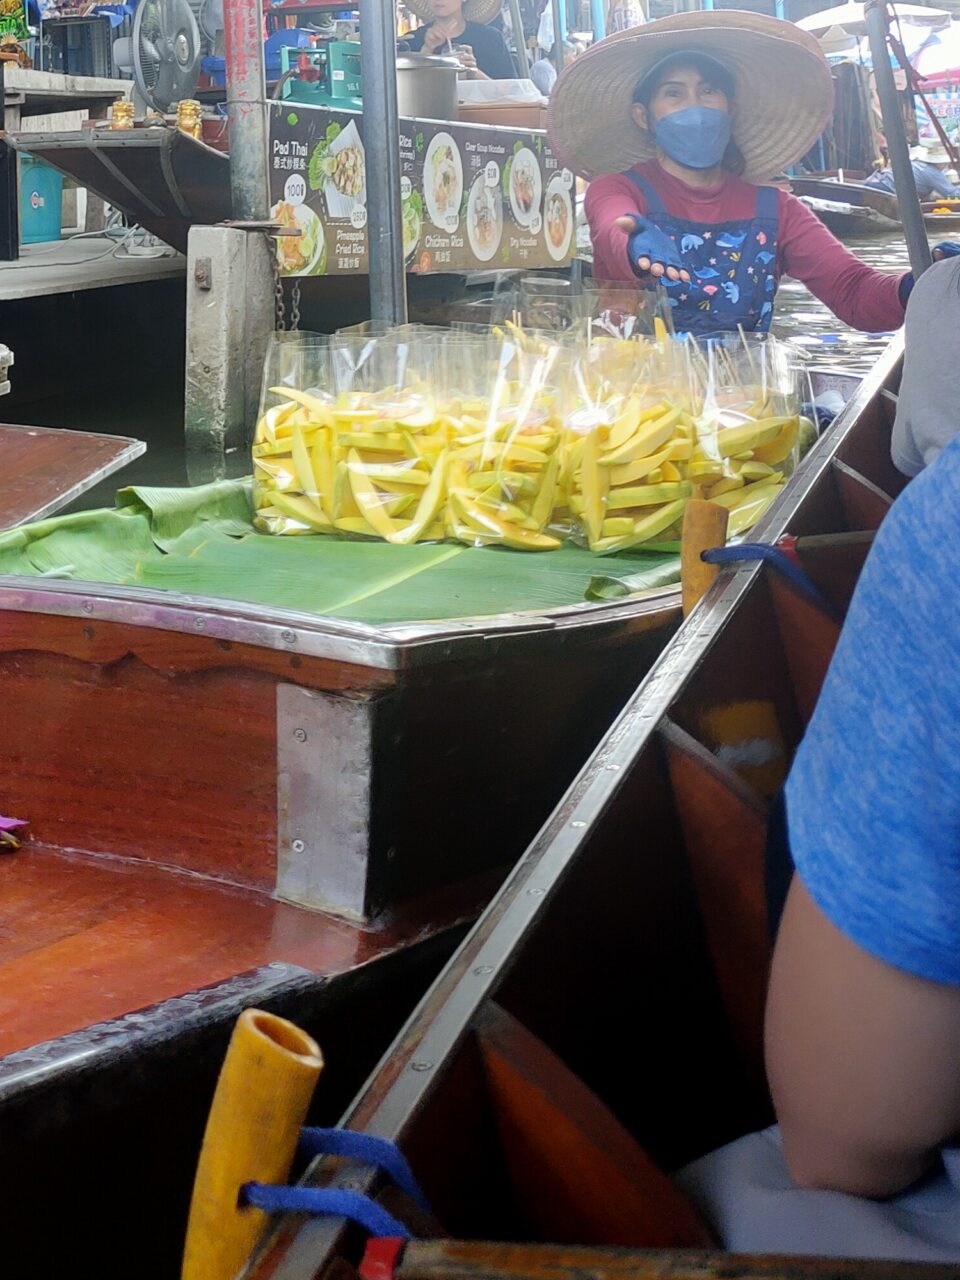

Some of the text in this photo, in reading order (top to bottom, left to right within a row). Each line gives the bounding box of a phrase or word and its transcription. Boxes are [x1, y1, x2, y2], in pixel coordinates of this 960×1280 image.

[273, 140, 308, 157] Pad Thai
[399, 135, 412, 148] Rice
[336, 229, 365, 243] Pineapple
[425, 234, 464, 248] Chicken Rice
[352, 243, 365, 255] Rice
